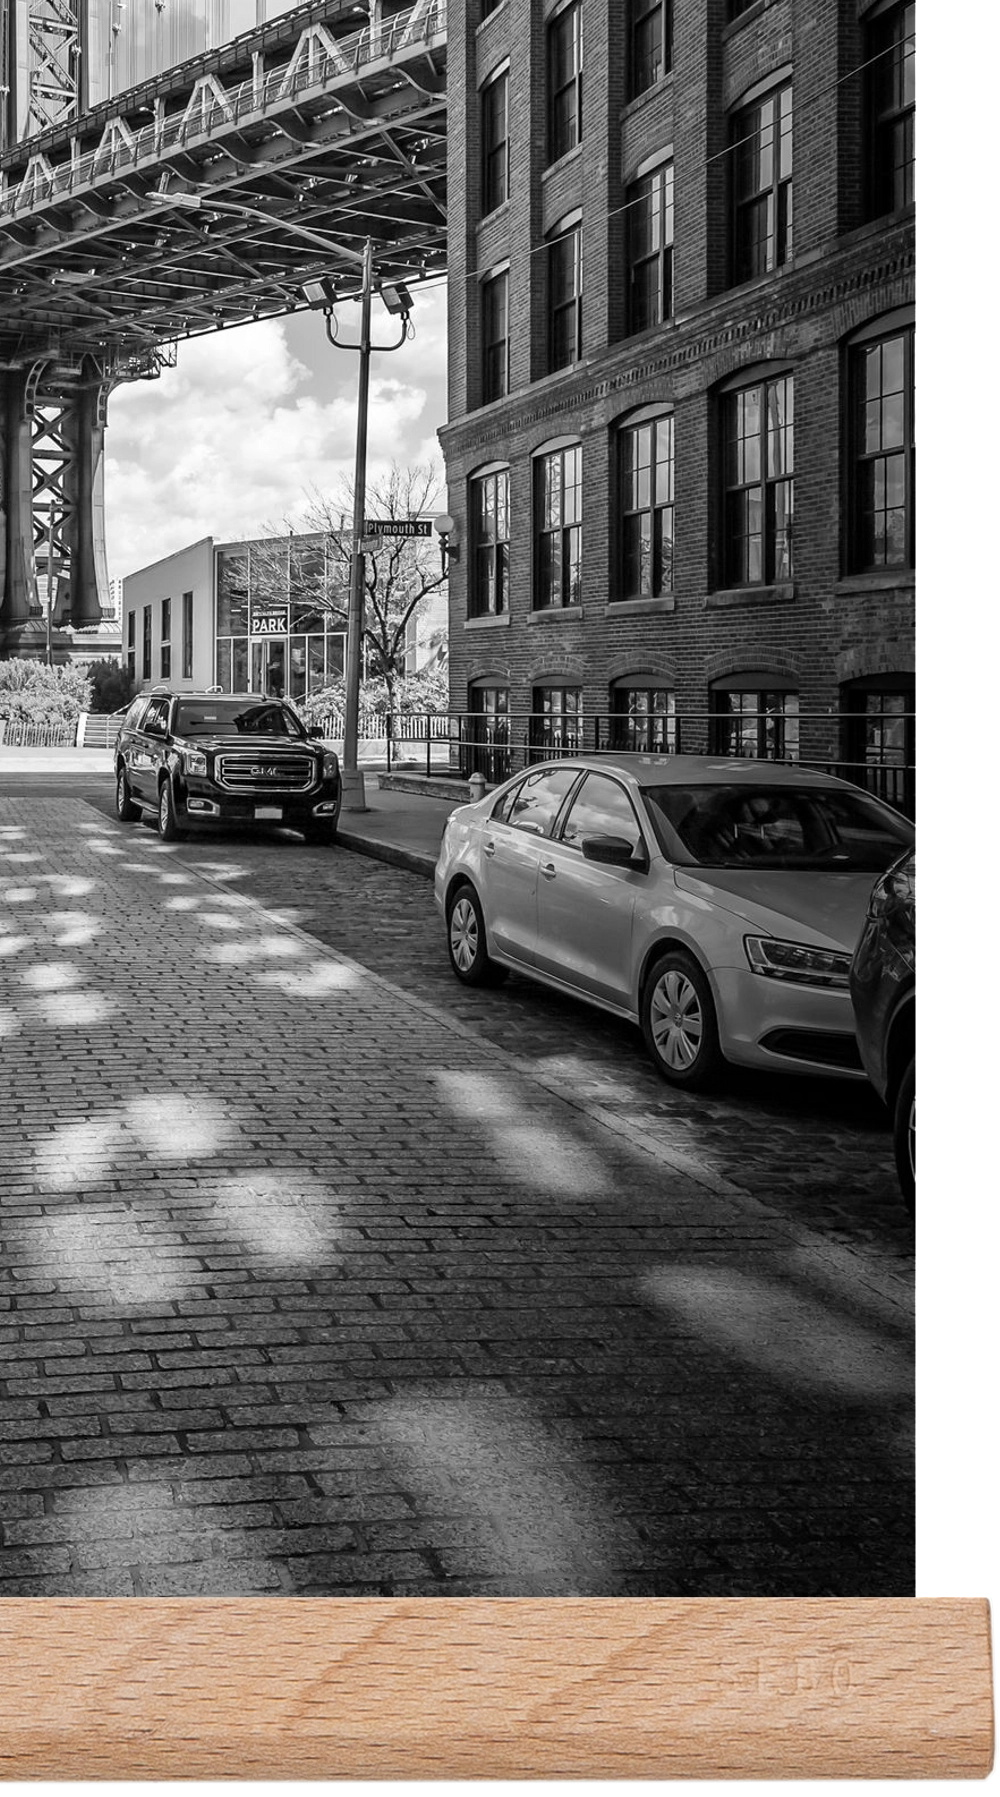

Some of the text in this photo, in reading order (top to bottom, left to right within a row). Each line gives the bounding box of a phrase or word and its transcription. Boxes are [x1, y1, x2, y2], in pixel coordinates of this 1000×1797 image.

[368, 523, 427, 535] Plymouth St
[253, 618, 287, 632] PARK
